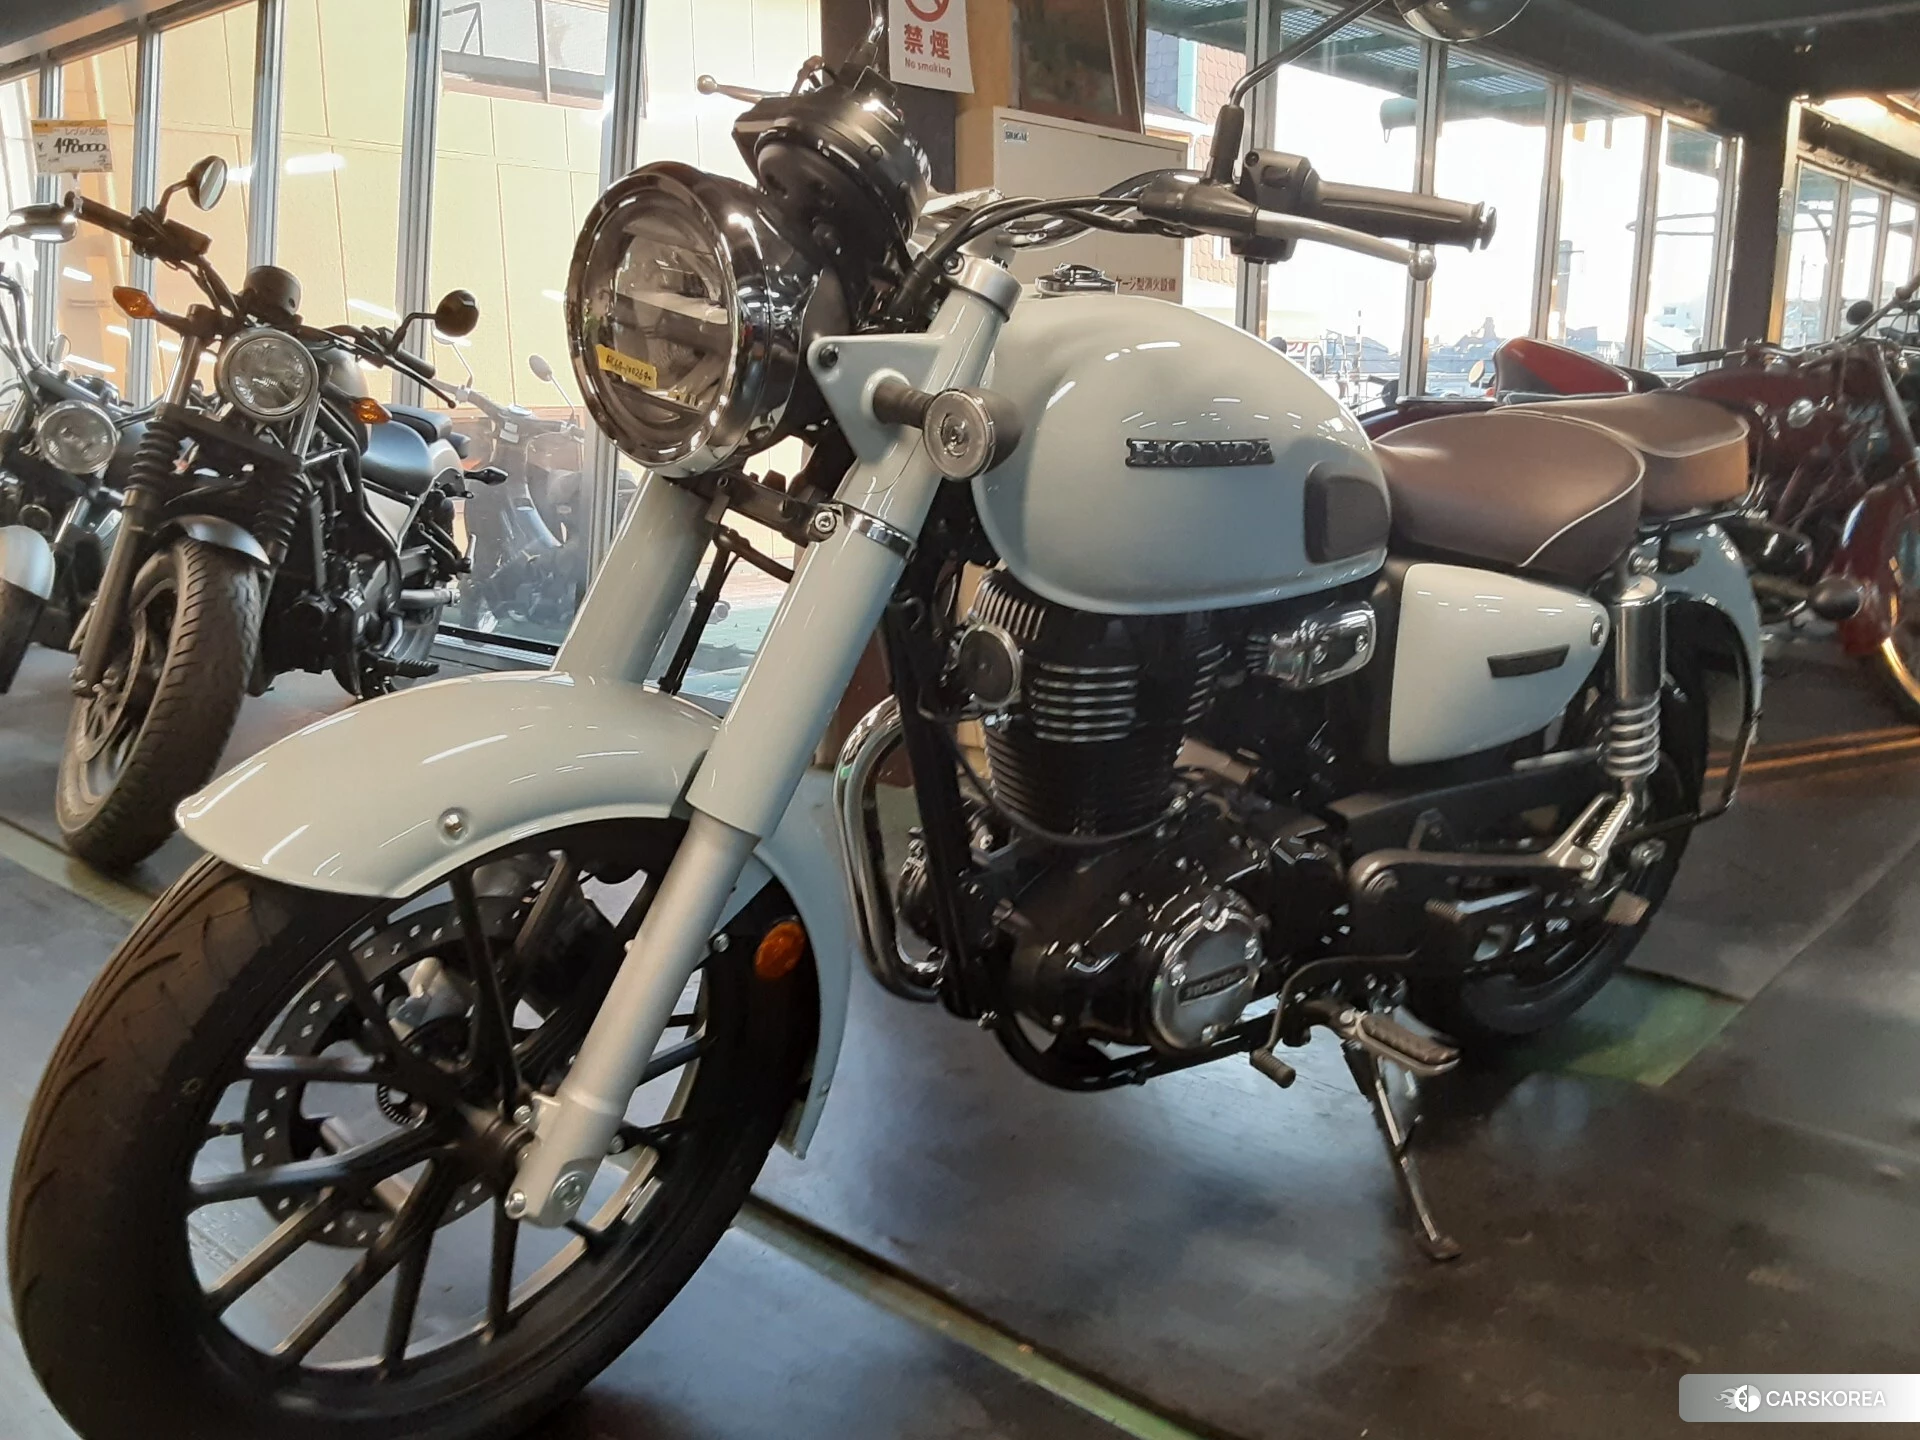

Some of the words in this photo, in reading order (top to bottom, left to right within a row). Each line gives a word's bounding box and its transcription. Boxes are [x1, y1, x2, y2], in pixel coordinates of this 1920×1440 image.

[904, 23, 950, 60] 禁煙
[904, 57, 916, 69] No
[917, 62, 951, 78] smoking
[1128, 438, 1275, 468] HONDA
